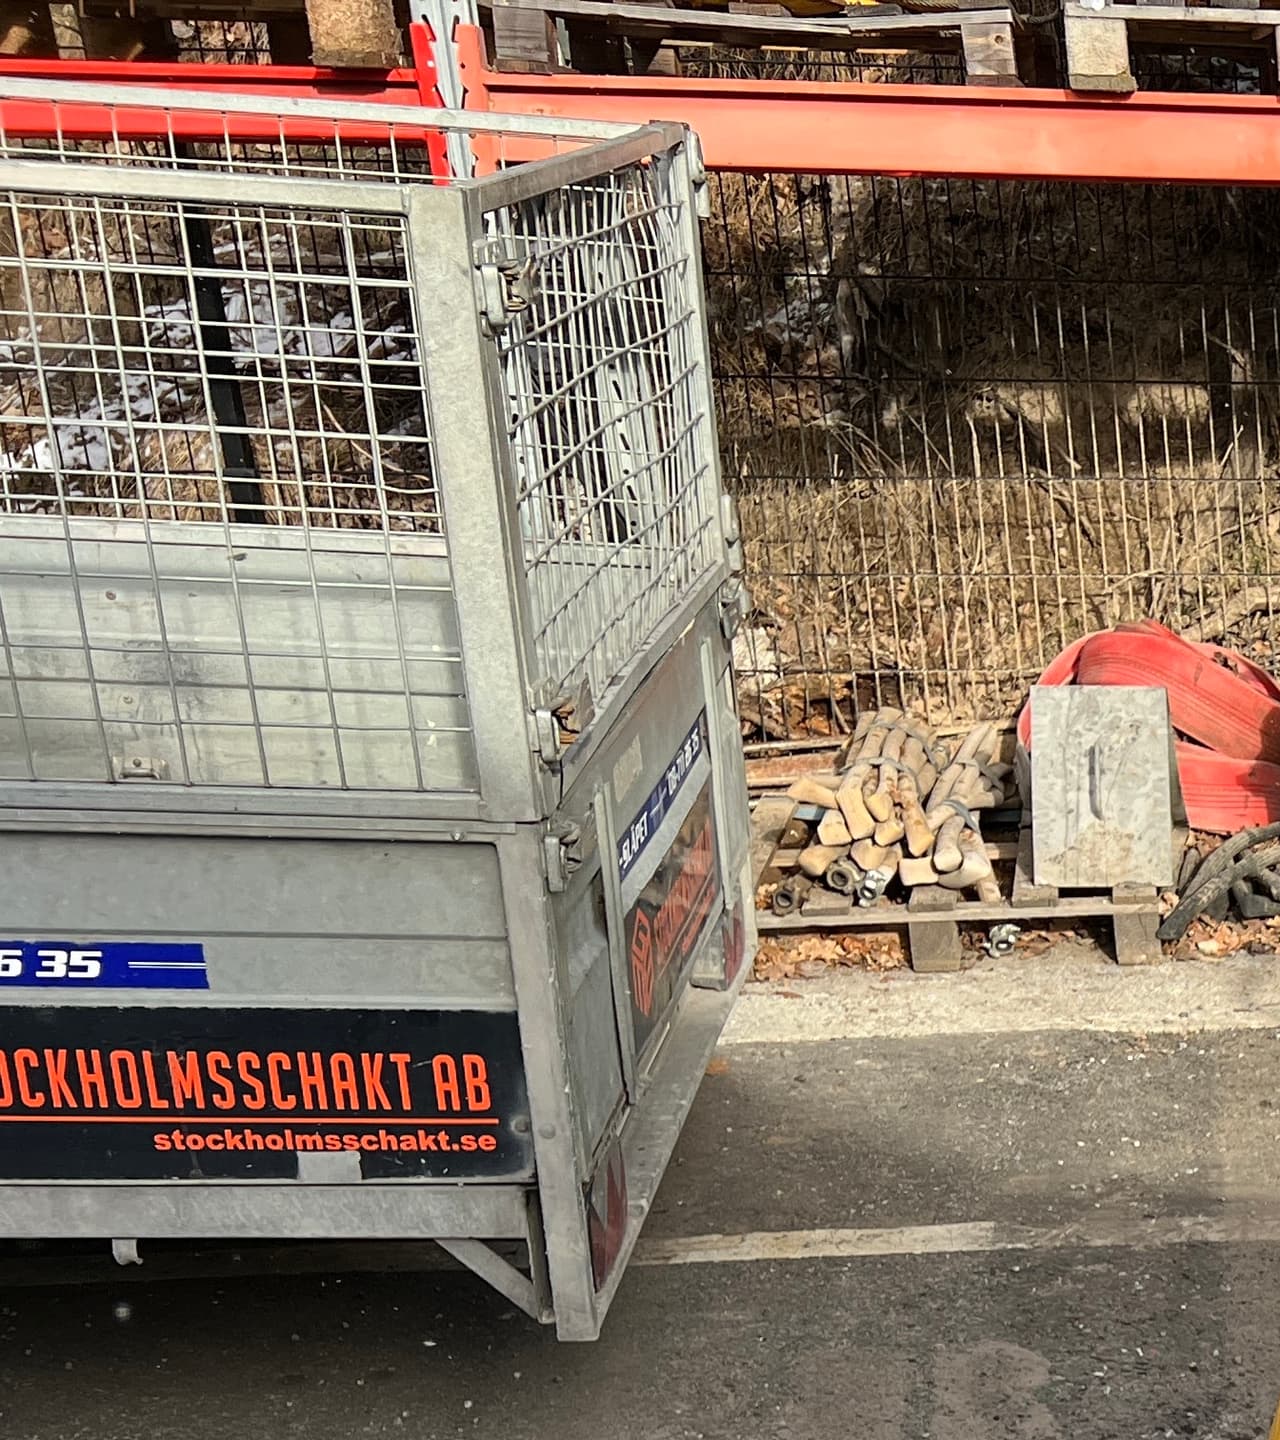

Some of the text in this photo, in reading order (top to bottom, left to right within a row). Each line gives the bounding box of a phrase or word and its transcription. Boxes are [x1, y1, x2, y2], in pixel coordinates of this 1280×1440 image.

[35, 949, 103, 979] 35
[432, 1053, 492, 1112] AB
[153, 1129, 497, 1153] stockholmsschakt.se
